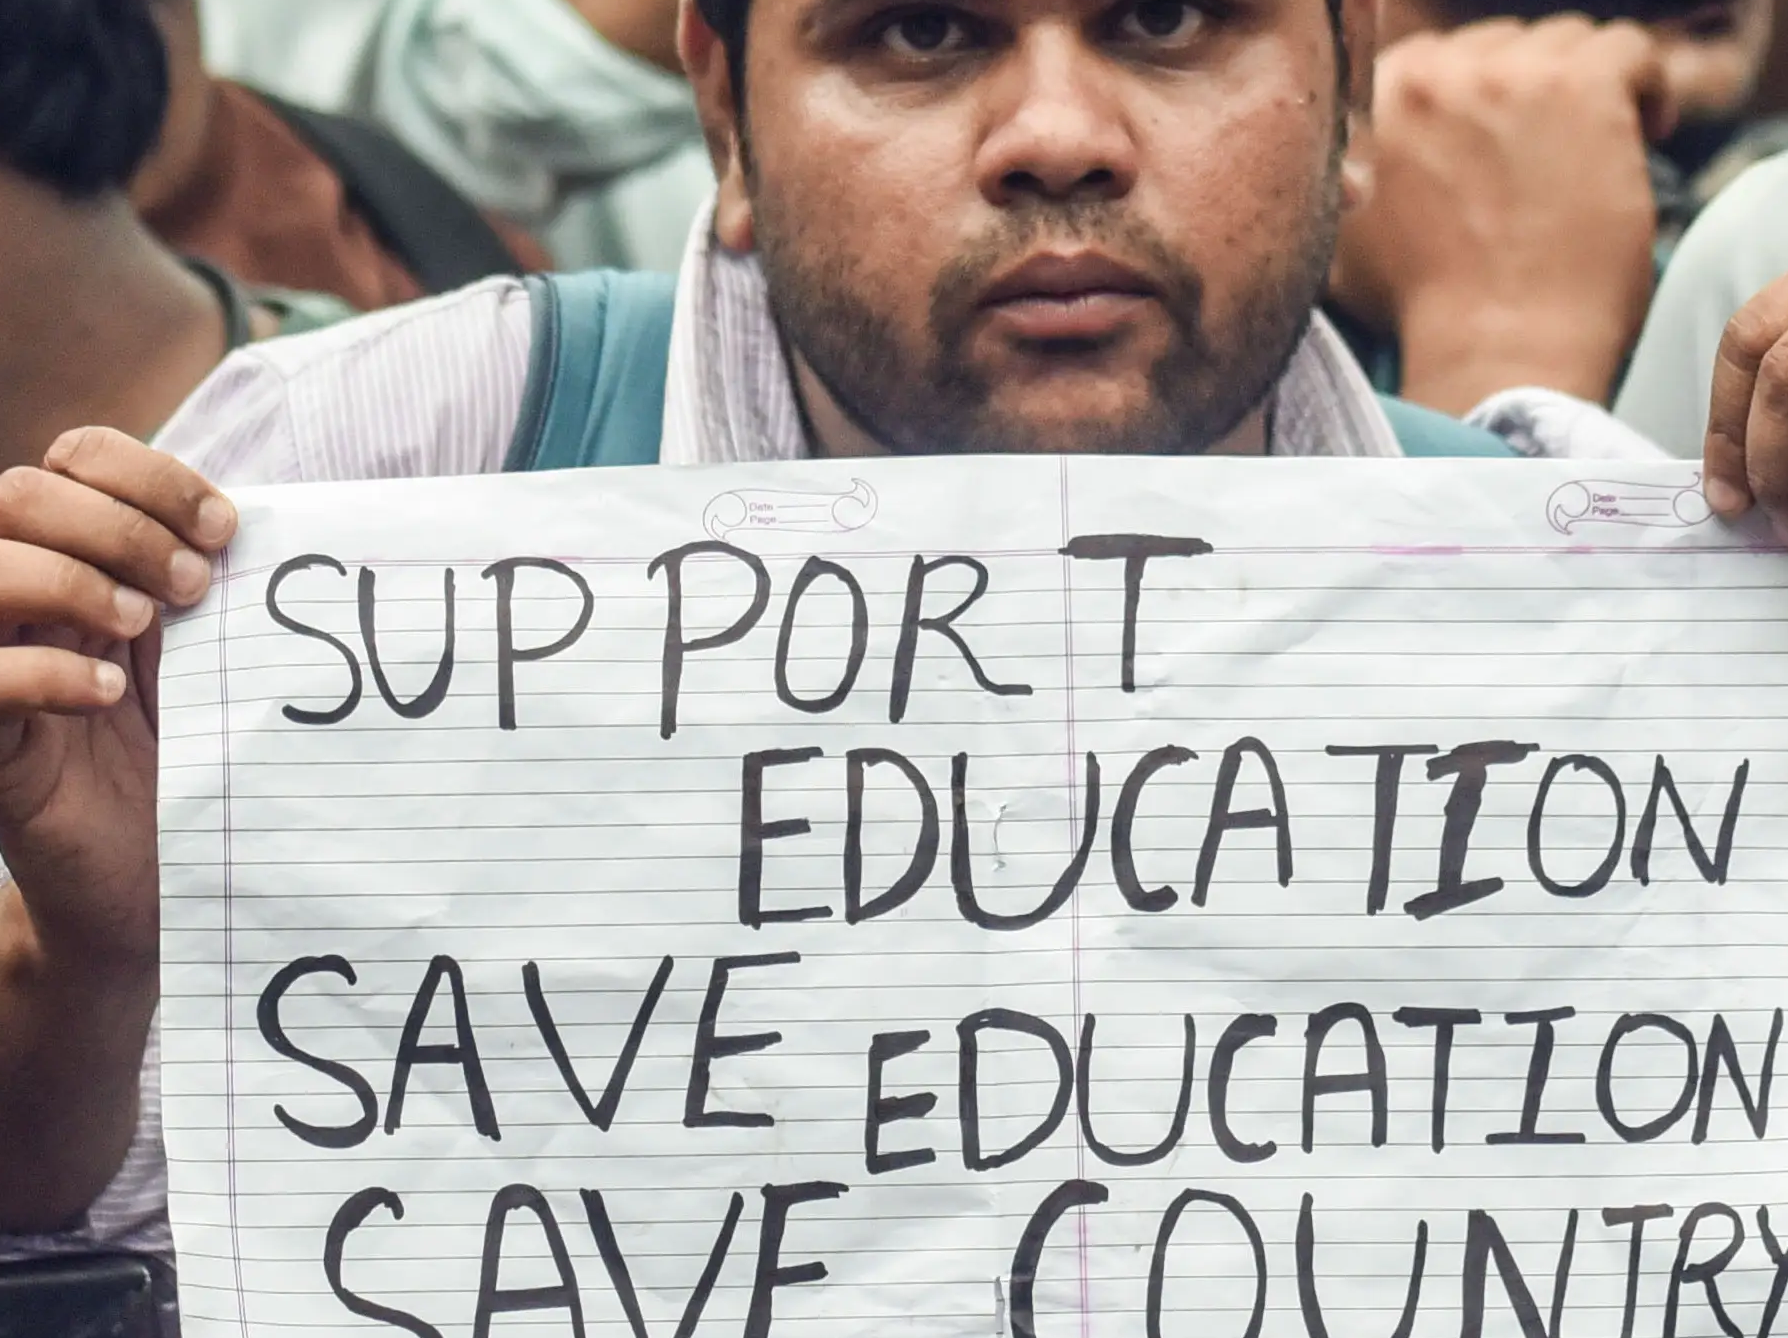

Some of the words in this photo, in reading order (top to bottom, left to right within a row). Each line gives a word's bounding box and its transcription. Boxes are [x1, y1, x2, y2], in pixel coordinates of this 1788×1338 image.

[1592, 493, 1616, 503] Date
[749, 502, 774, 511] Date
[1592, 506, 1619, 517] Page
[749, 515, 777, 525] Page
[262, 534, 1212, 735] SUPPORT
[739, 738, 1750, 931] EDUCATION
[257, 952, 801, 1149] SAVE
[865, 1007, 1784, 1174] EDUCATION
